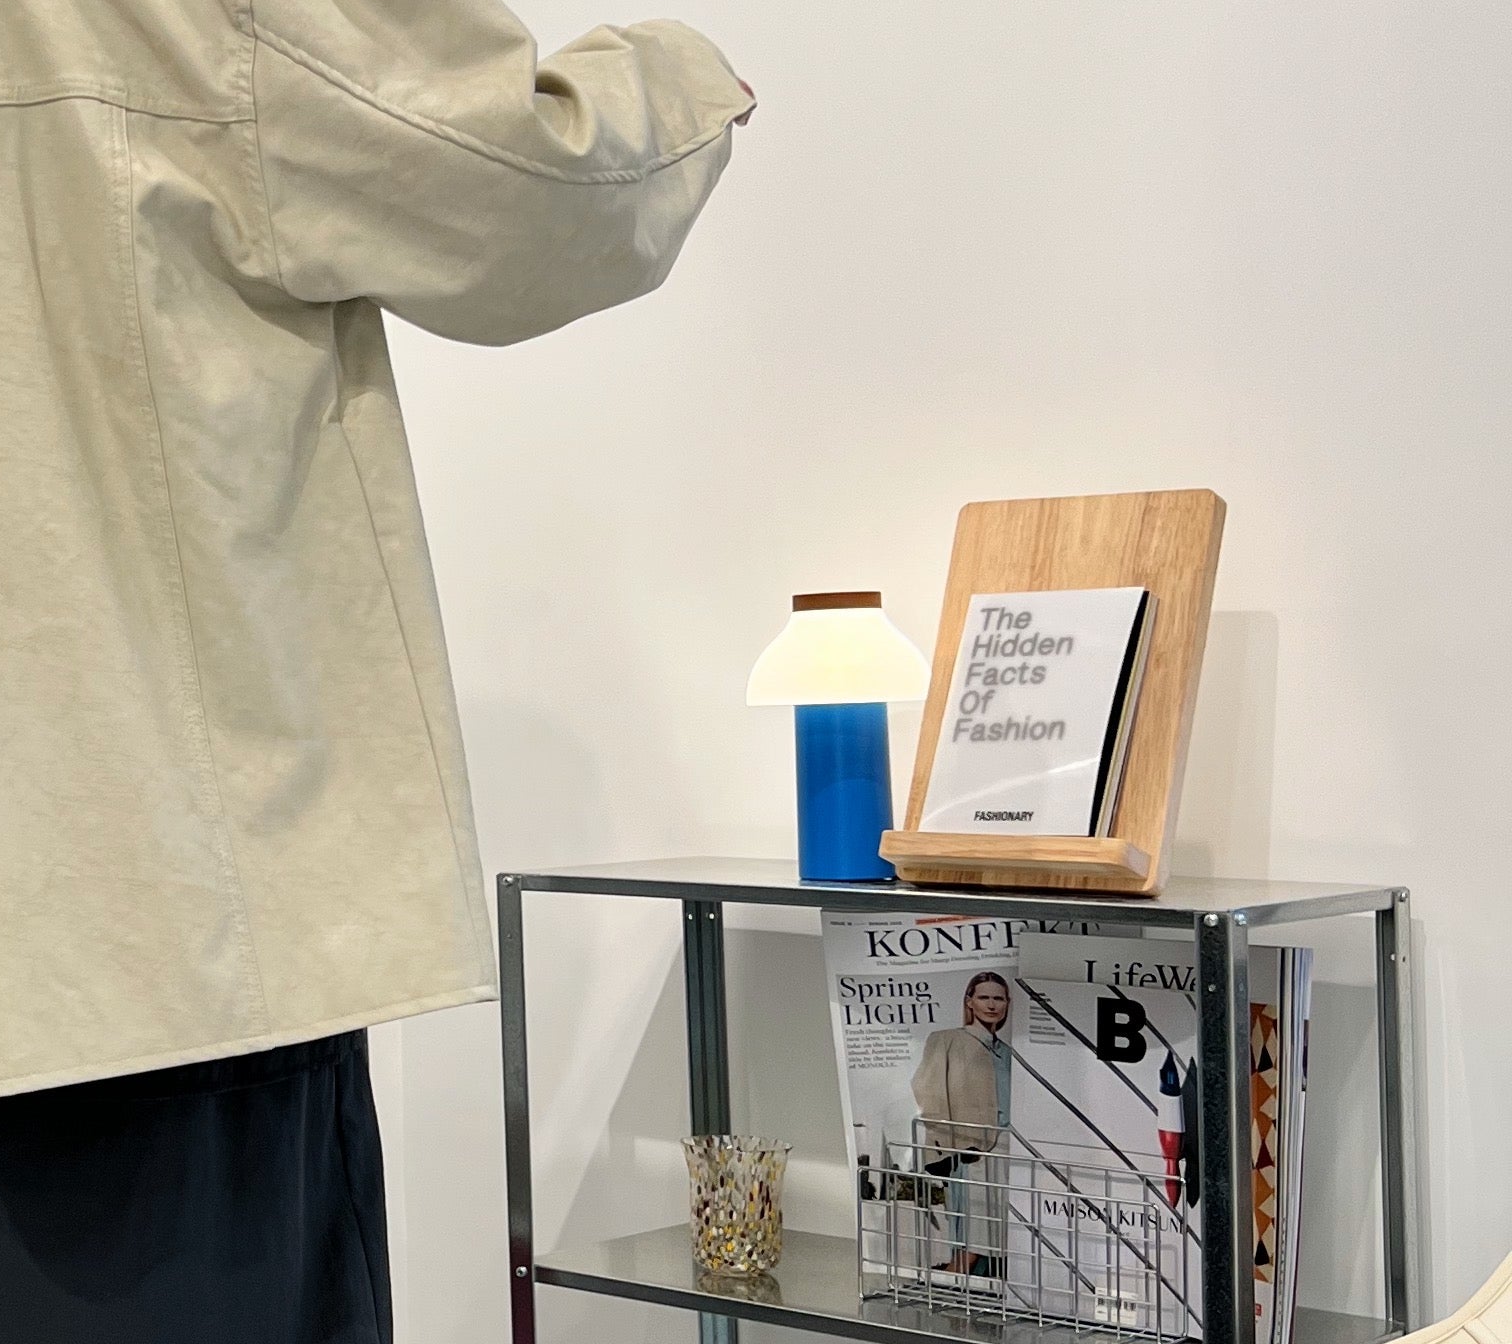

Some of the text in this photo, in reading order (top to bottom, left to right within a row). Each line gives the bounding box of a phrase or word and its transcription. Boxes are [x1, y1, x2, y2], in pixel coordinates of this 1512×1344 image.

[980, 607, 1032, 631] The
[971, 632, 1074, 658] Hidden
[965, 662, 1047, 687] Facts
[959, 689, 996, 715] Of
[952, 716, 1066, 743] Fashion
[974, 810, 1034, 822] FASHIONARY
[840, 977, 932, 1003] Spring
[844, 1002, 941, 1025] LIGHT
[1097, 996, 1147, 1064] B
